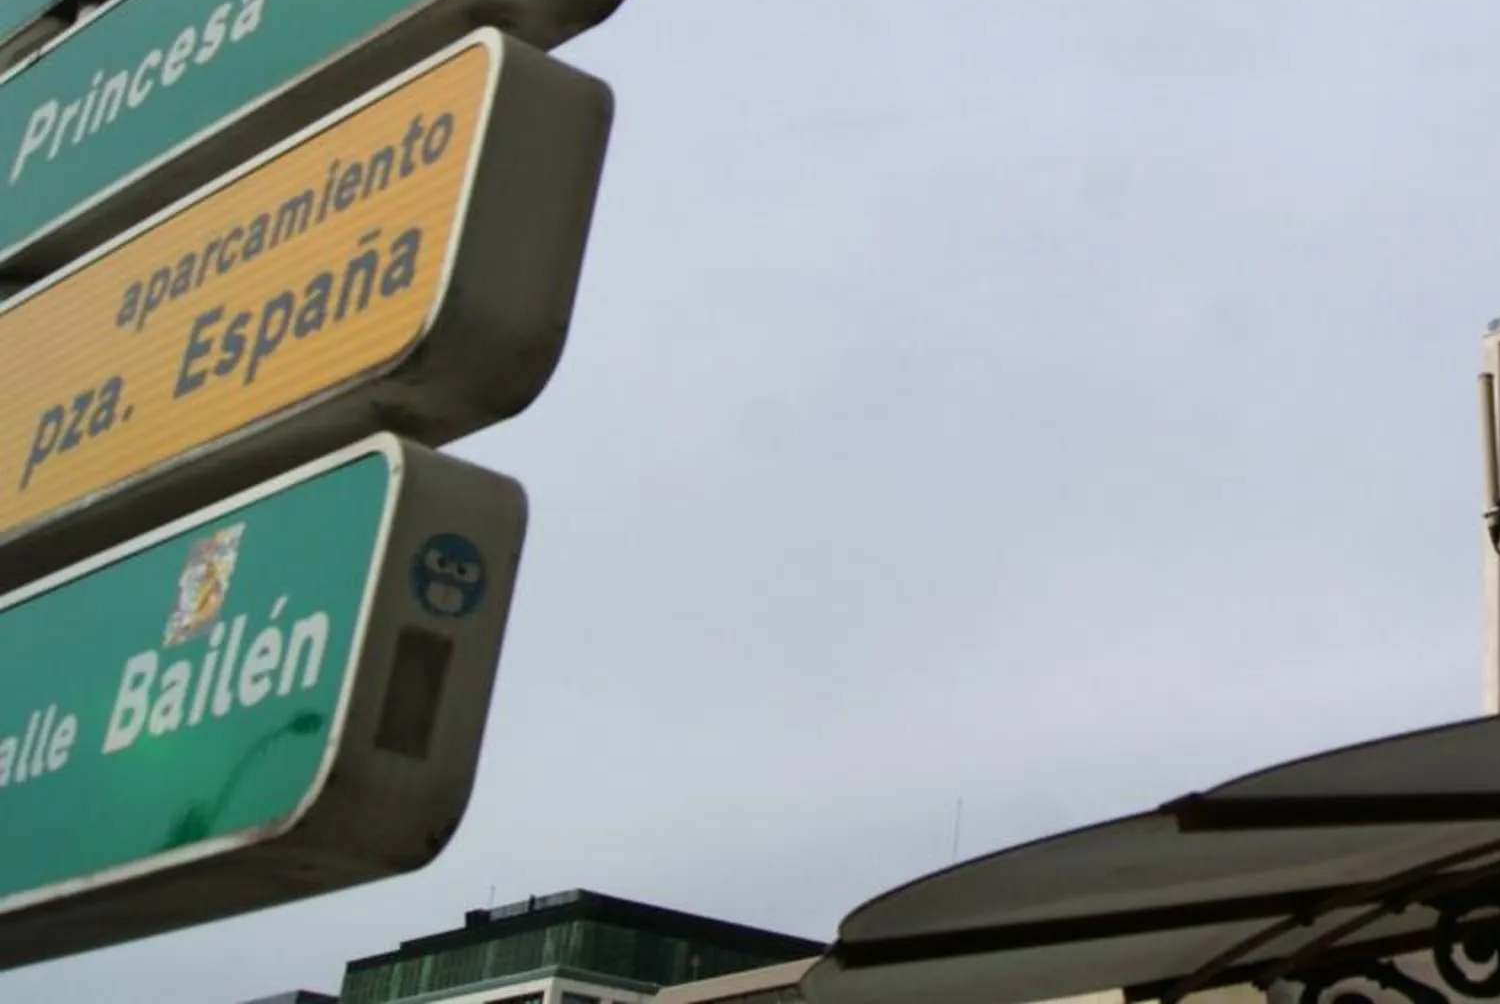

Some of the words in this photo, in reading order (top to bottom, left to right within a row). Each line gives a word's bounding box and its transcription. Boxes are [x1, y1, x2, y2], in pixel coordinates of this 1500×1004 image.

[117, 111, 454, 331] aparcamiento
[21, 375, 133, 489] pza.
[173, 226, 423, 398] España
[102, 595, 329, 755] Bailén
